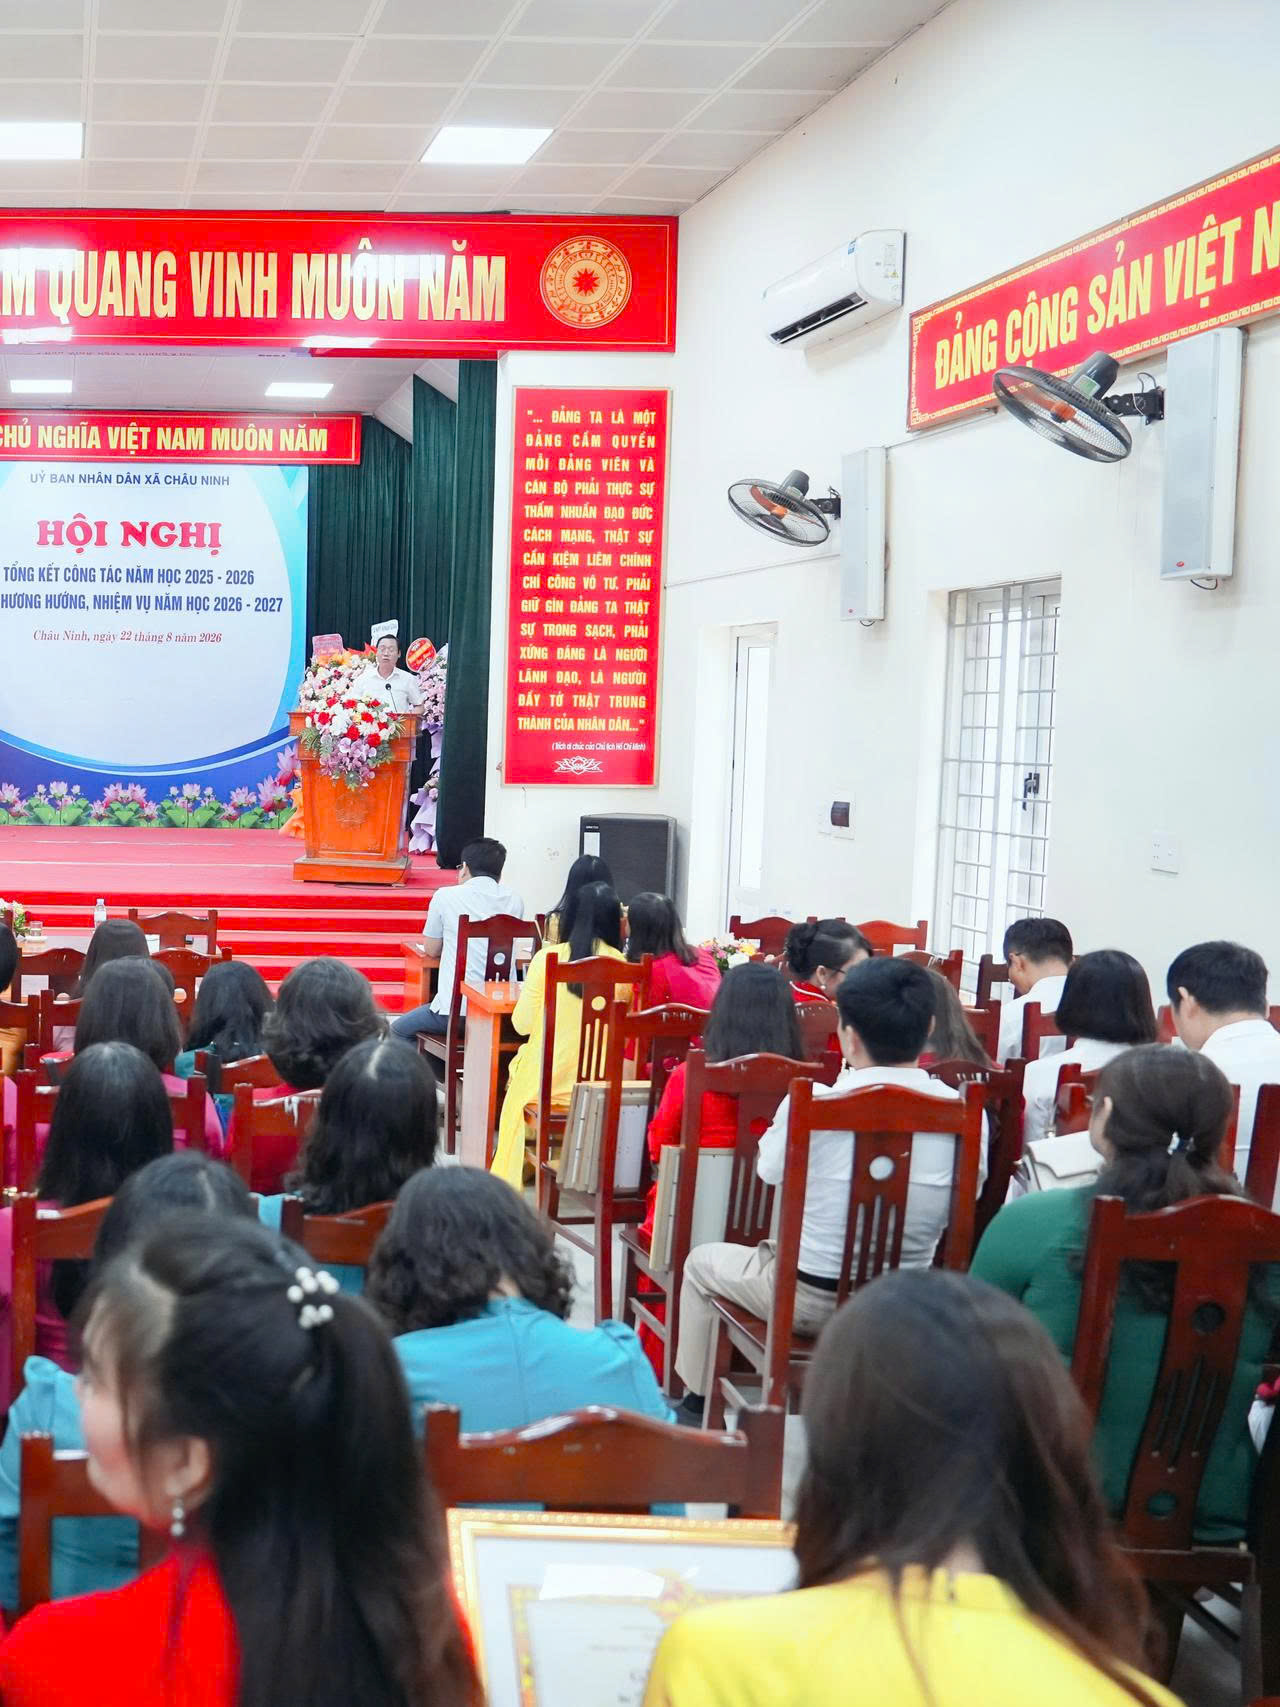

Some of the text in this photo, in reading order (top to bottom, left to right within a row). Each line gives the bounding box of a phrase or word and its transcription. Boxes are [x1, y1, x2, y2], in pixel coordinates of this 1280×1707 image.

[48, 250, 177, 325] QUANG
[190, 251, 277, 319] VINH
[291, 239, 406, 321] MUÔN
[419, 239, 507, 322] NĂM
[935, 311, 997, 389] ĐẢNG
[1005, 291, 1078, 369] CỘNG
[1087, 240, 1152, 334] SẢN
[1163, 214, 1242, 309] VIỆT
[552, 406, 580, 423] ĐẢNG
[590, 411, 602, 424] TA
[612, 409, 624, 424] LÀ
[633, 410, 656, 426] MỘT
[38, 422, 100, 449] NGHĨA
[108, 422, 150, 454] VIỆT
[157, 427, 204, 450] NAM
[211, 423, 272, 451] MUÔN
[280, 425, 327, 451] NĂM
[559, 454, 591, 471] ĐẢNG
[602, 457, 629, 471] VIÊN
[640, 457, 654, 471] VÀ
[51, 474, 74, 483] BAN
[79, 472, 112, 484] NHÂN
[116, 472, 140, 484] DÂN
[145, 473, 160, 484] XÃ
[164, 473, 197, 485] CHÂU
[201, 476, 229, 485] NINH
[525, 477, 654, 497] CÁN BỘ PHẢI THỰC SỰ
[37, 513, 221, 555] HỘI NGHỊ
[524, 527, 552, 541] CÁCH
[604, 528, 629, 545] THẬT
[638, 530, 653, 545] SỰ
[4, 561, 34, 582] TỔNG
[39, 563, 60, 582] KẾT
[64, 564, 96, 582] CÔNG
[100, 565, 122, 583] TÁC
[126, 565, 153, 583] NĂM
[158, 569, 181, 587] HỌC
[185, 569, 213, 584] 2025
[226, 570, 254, 585] 2026
[523, 574, 540, 588] CHÍ
[548, 574, 576, 589] CÔNG
[583, 575, 596, 589] VÔ
[626, 574, 650, 590] PHẢI
[45, 591, 89, 611] HƯỚNG,
[93, 592, 132, 613] NHIỆM
[136, 595, 151, 613] VỤ
[155, 593, 182, 611] NĂM
[186, 596, 209, 614] HỌC
[214, 597, 242, 611] 2026
[254, 597, 283, 612] 2027
[521, 596, 649, 616] GIỮ GÌN ĐẢNG TA THẬT
[34, 630, 223, 644] Châu Ninh, ngày 22 tháng 8 năm 2026
[521, 623, 536, 638] SỰ
[543, 624, 576, 636] TRONG
[624, 621, 648, 637] PHẢI
[518, 716, 551, 730] THÀNH
[554, 713, 574, 730] CỦA
[577, 716, 606, 731] NHÂN
